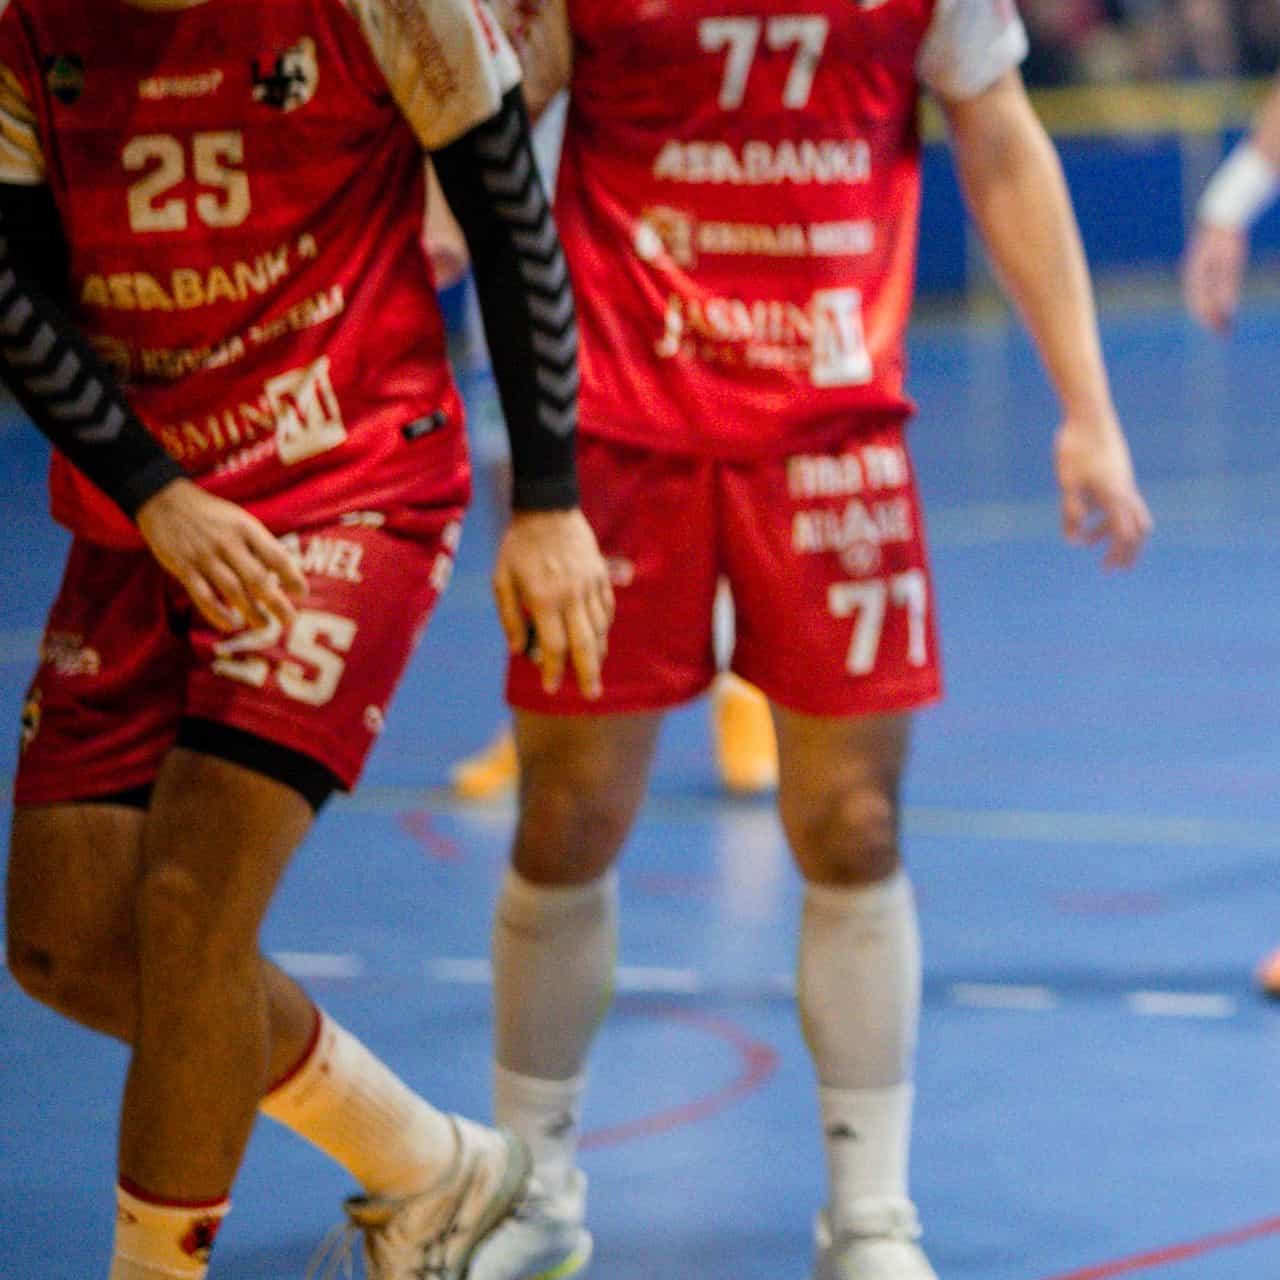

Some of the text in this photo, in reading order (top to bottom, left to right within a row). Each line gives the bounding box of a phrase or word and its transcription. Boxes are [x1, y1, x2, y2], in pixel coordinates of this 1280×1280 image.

[698, 15, 830, 111] 77
[121, 130, 252, 234] 25
[212, 603, 359, 698] 25
